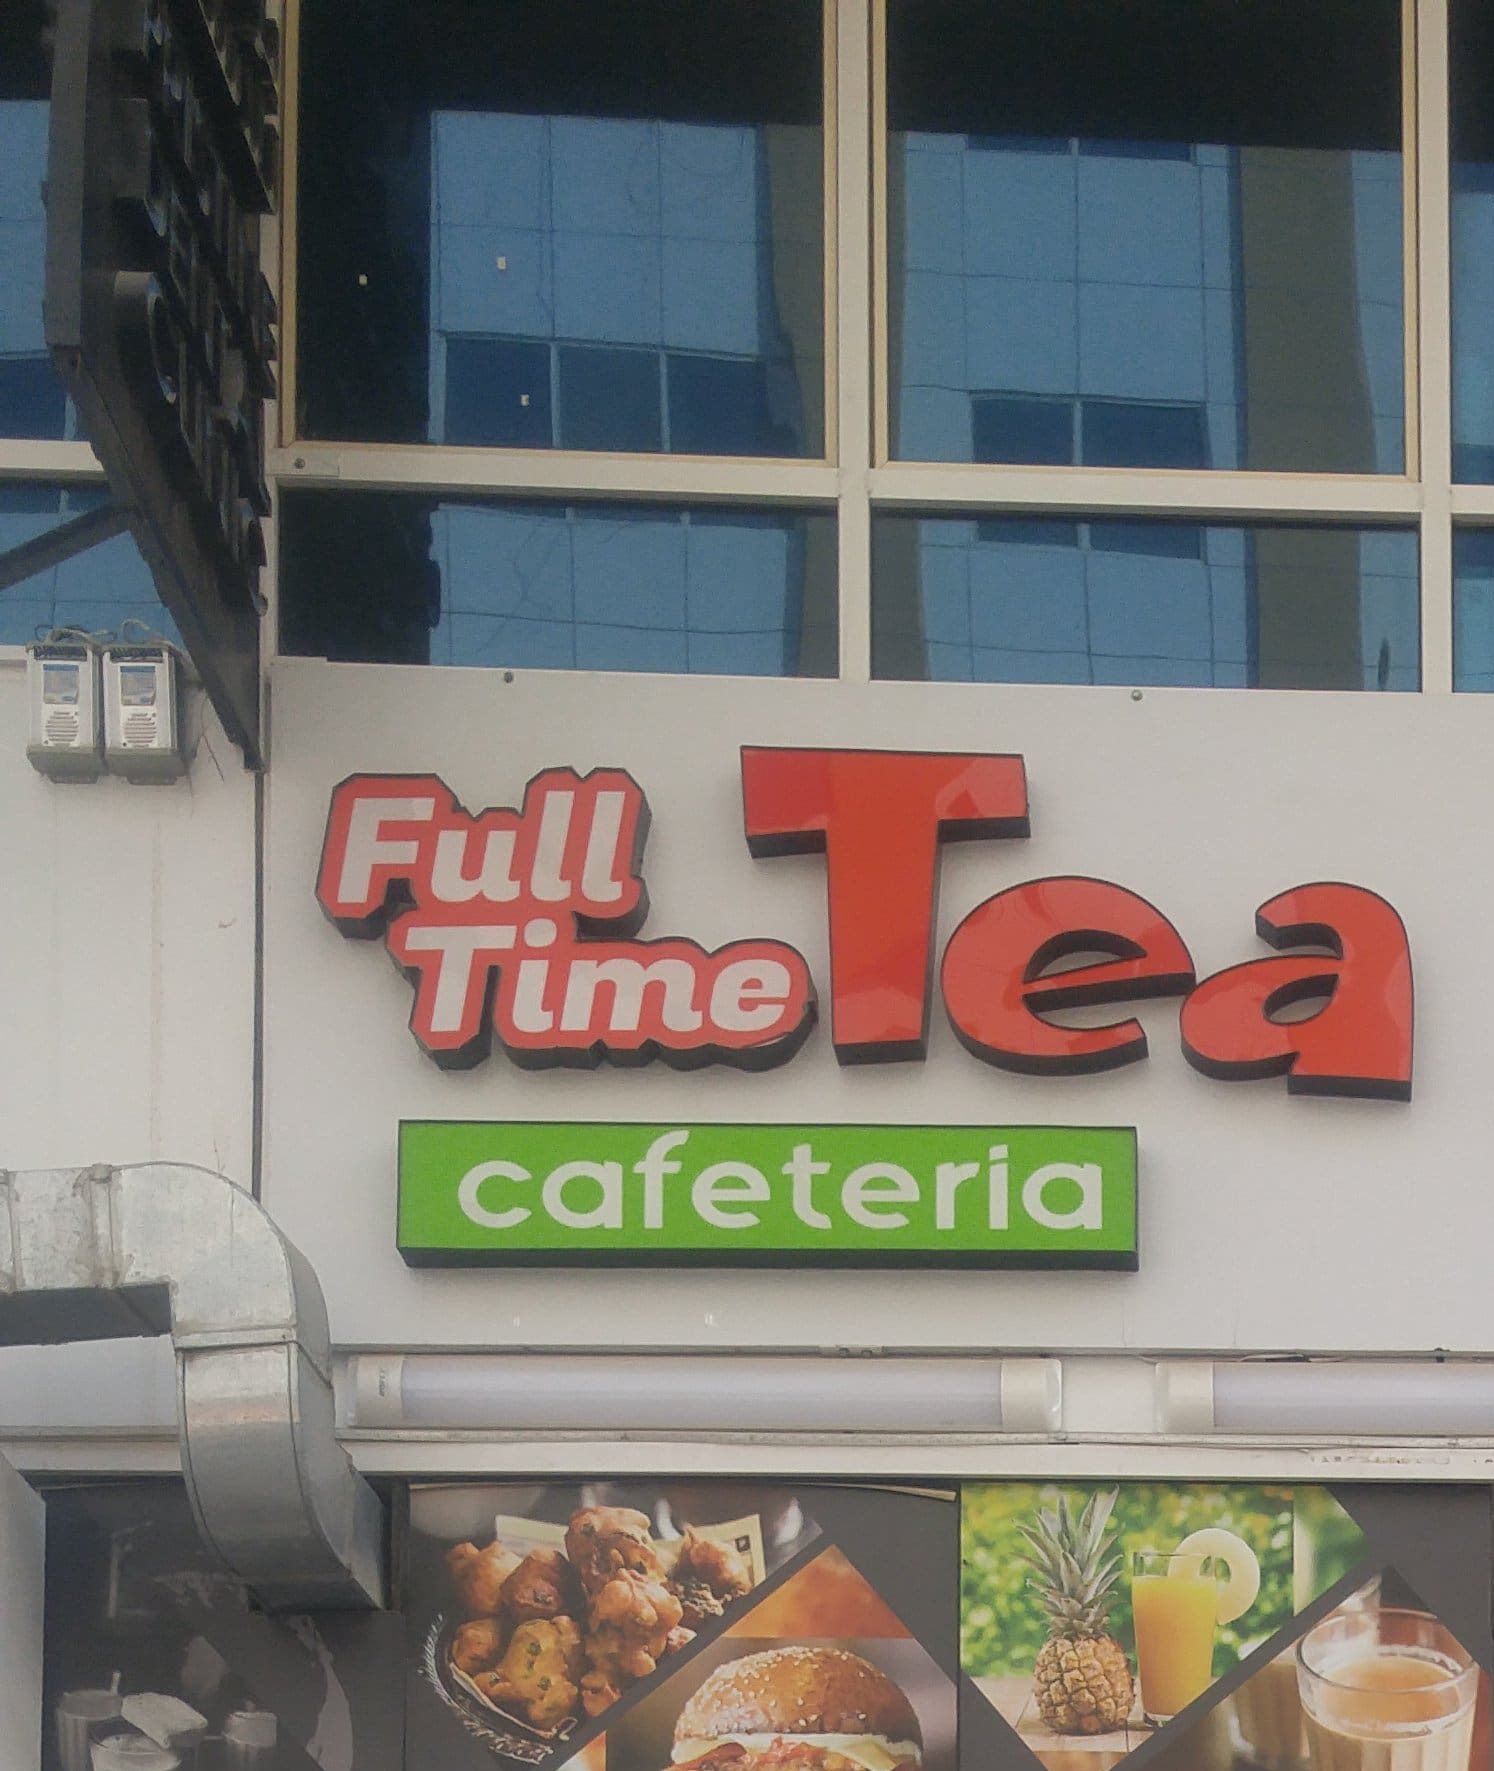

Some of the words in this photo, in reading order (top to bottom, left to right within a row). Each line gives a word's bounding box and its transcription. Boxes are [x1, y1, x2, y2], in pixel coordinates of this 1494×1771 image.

[335, 788, 639, 909] Full
[402, 917, 794, 1038] Time
[740, 745, 1415, 1101] Tea
[456, 1127, 1106, 1234] cafeteria
